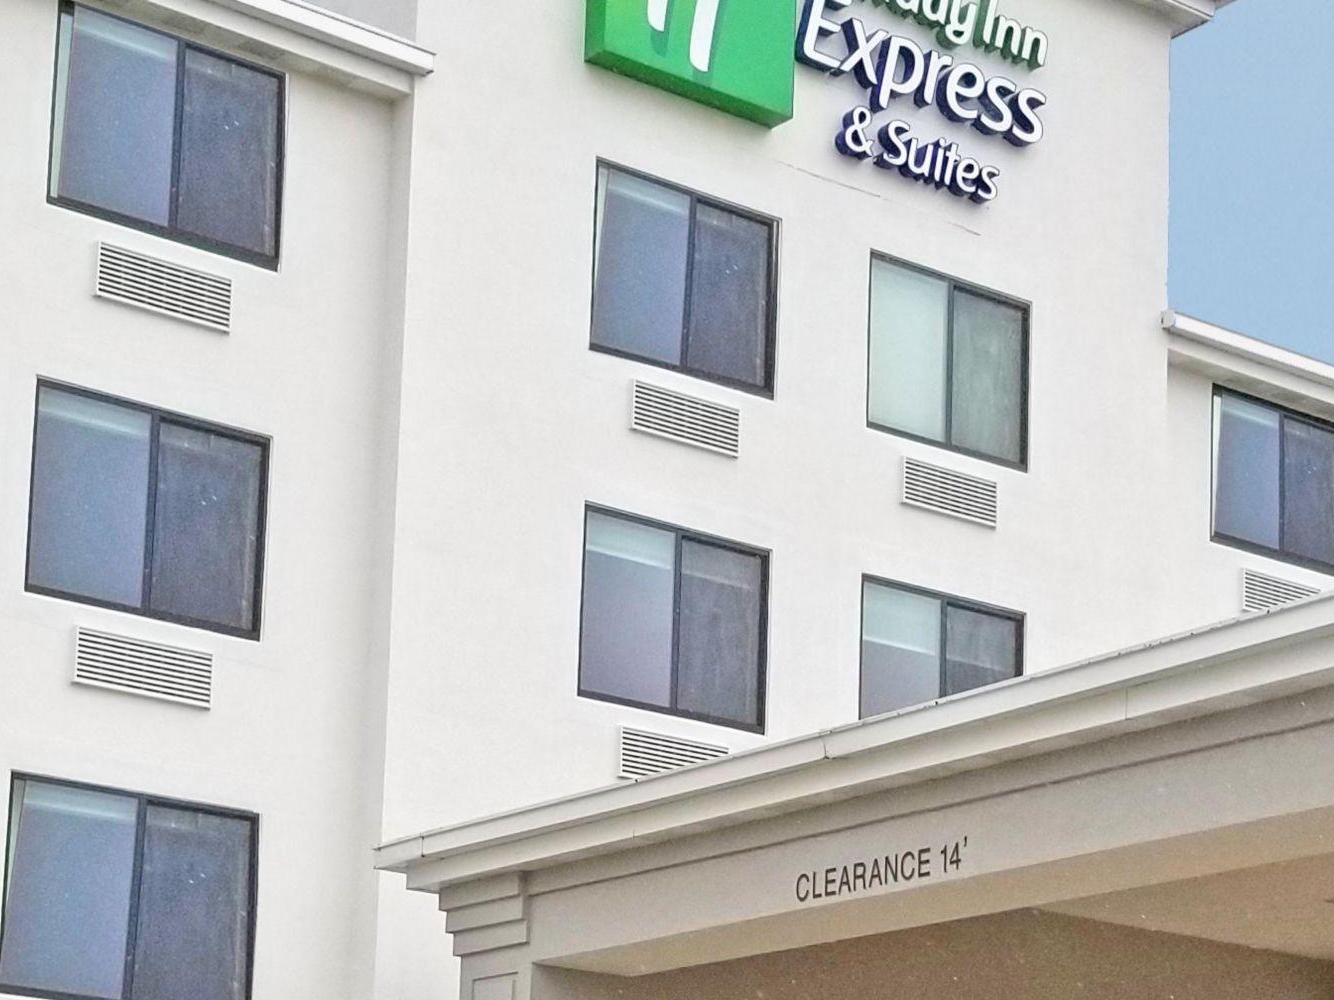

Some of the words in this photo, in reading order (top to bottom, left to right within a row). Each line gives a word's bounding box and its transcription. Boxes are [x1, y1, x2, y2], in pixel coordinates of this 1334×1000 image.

[801, 0, 1047, 144] Express
[981, 0, 1049, 66] Inn
[843, 105, 874, 158] &
[881, 119, 1001, 201] Suites
[795, 847, 931, 902] CLEARANCE
[939, 835, 968, 873] 14'
